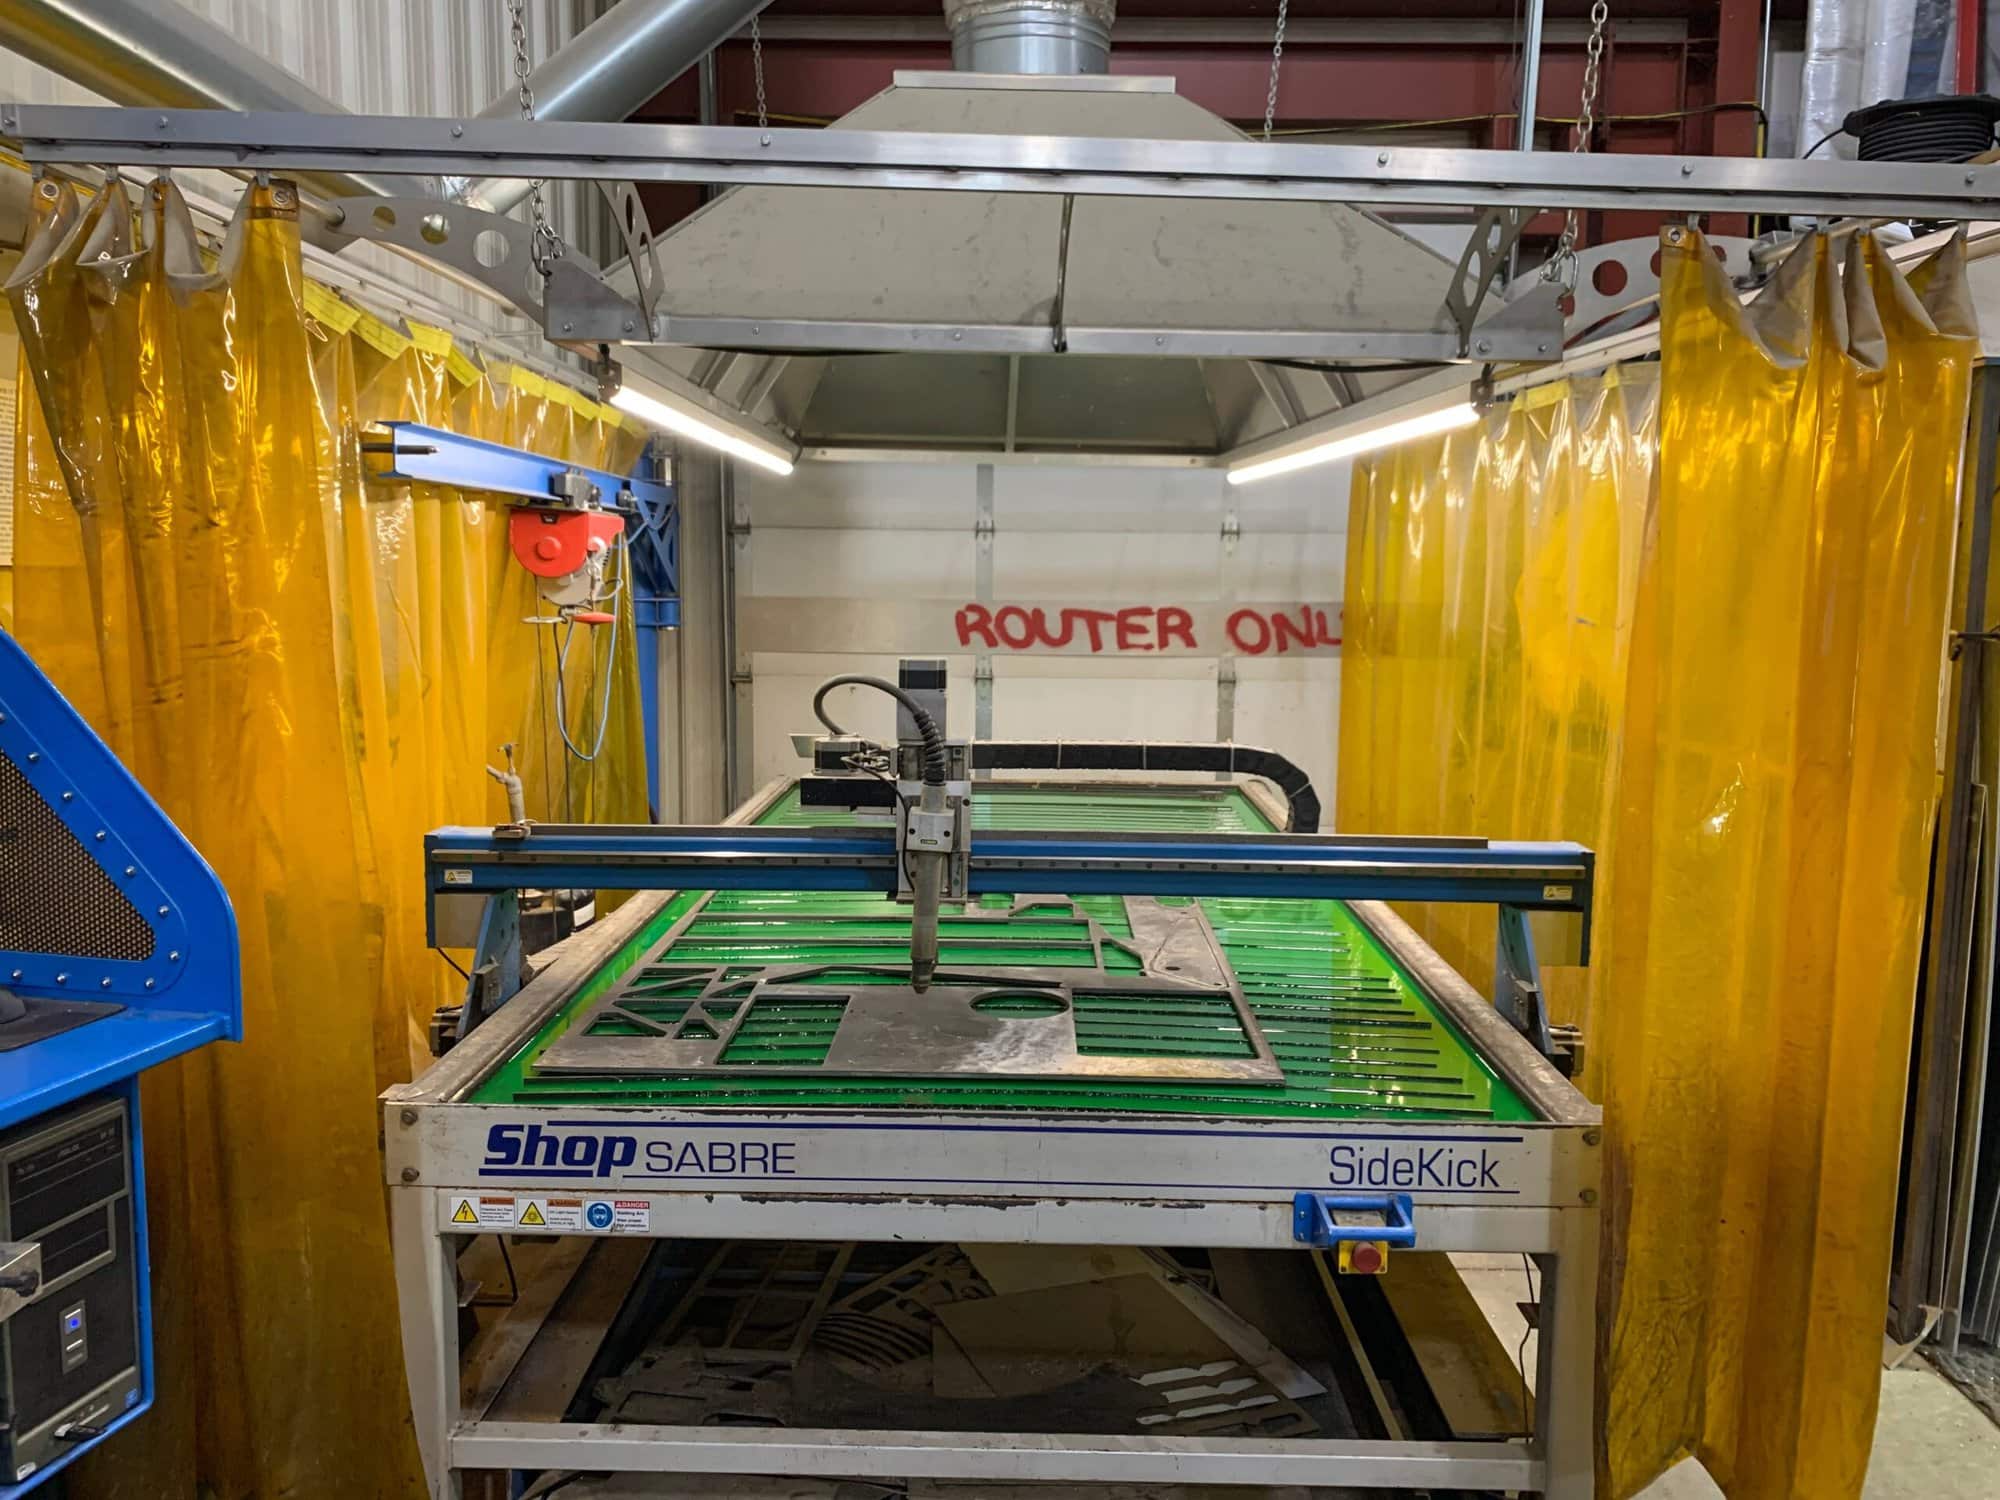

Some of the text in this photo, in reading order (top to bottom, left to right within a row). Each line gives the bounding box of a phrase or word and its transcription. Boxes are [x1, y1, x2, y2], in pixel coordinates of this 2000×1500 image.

[955, 603, 1344, 655] ROUTER ONL
[484, 1124, 797, 1178] Shop SABRE
[1328, 1145, 1500, 1188] SideKick
